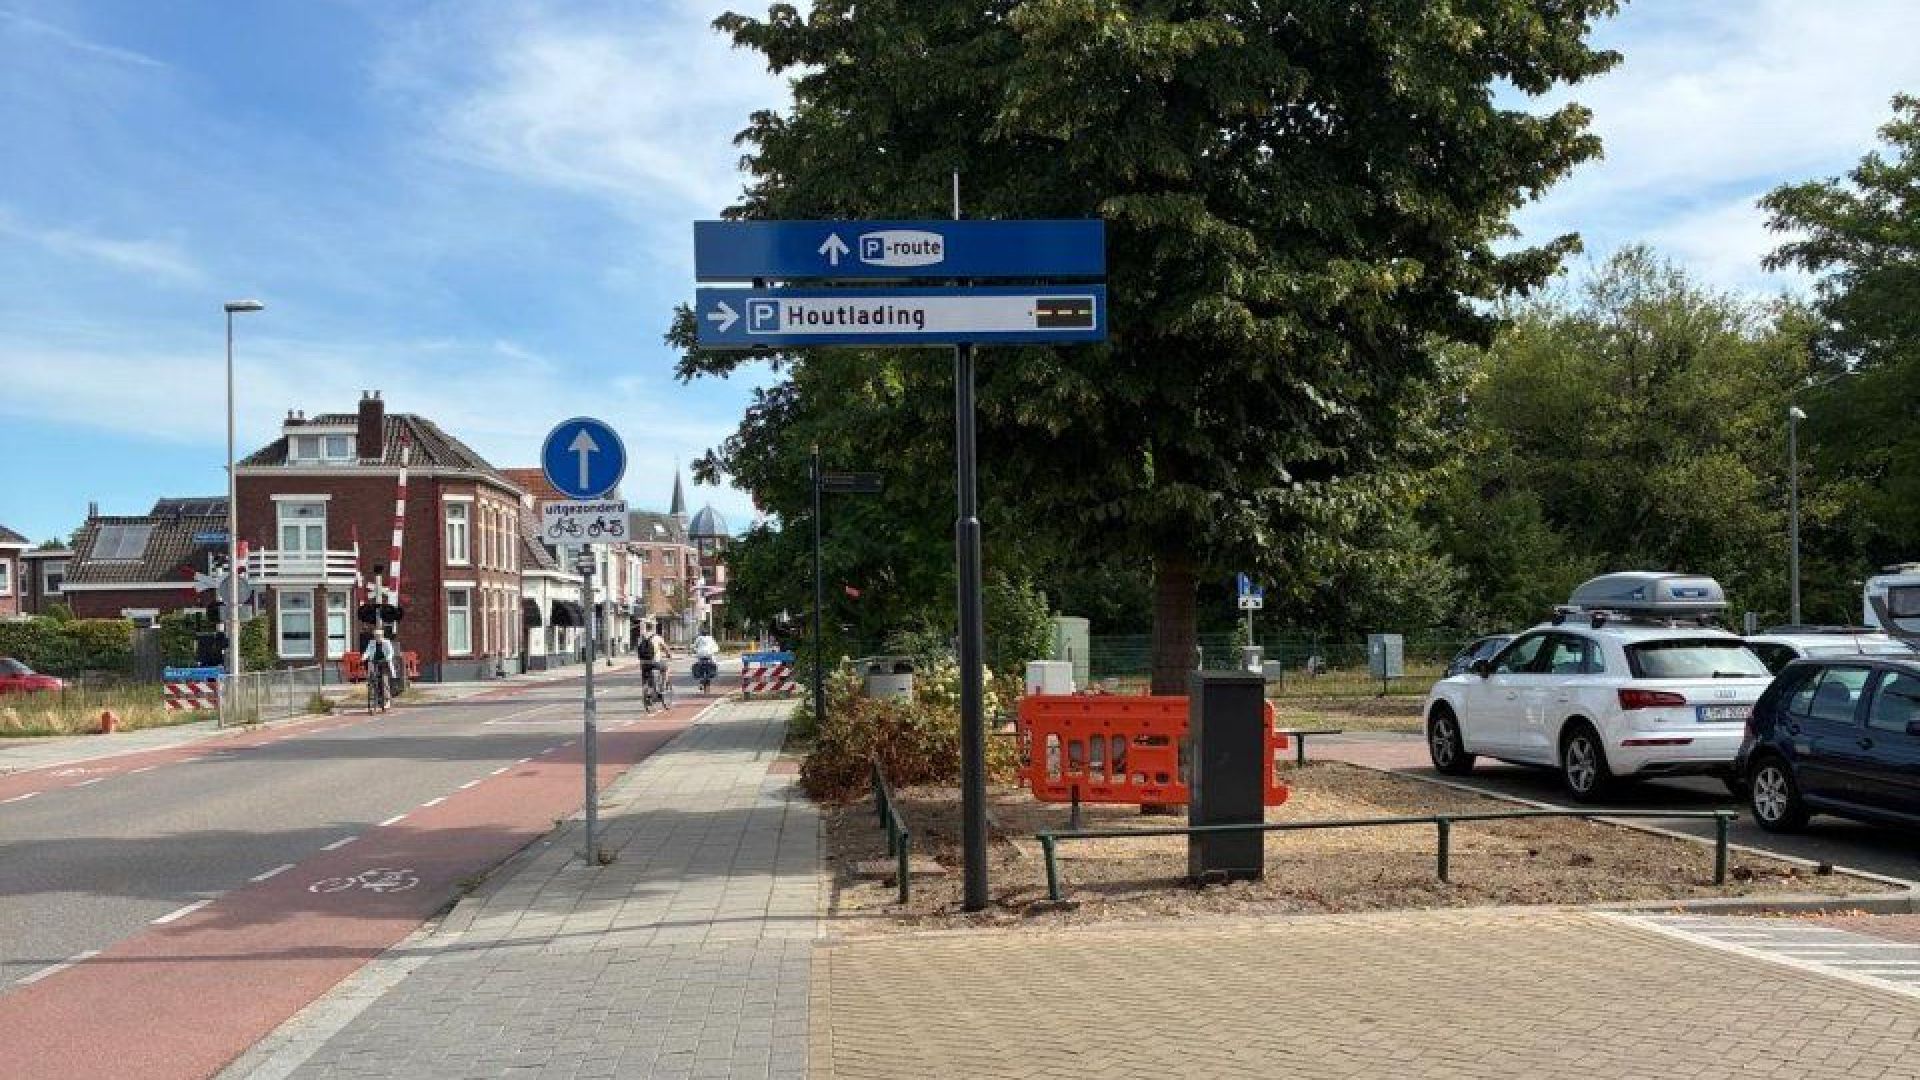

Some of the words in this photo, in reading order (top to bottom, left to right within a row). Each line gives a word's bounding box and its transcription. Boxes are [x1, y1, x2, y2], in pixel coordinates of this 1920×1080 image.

[755, 305, 773, 329] P
[788, 305, 925, 331] Houtlading
[545, 503, 625, 517] uitgezonderd
